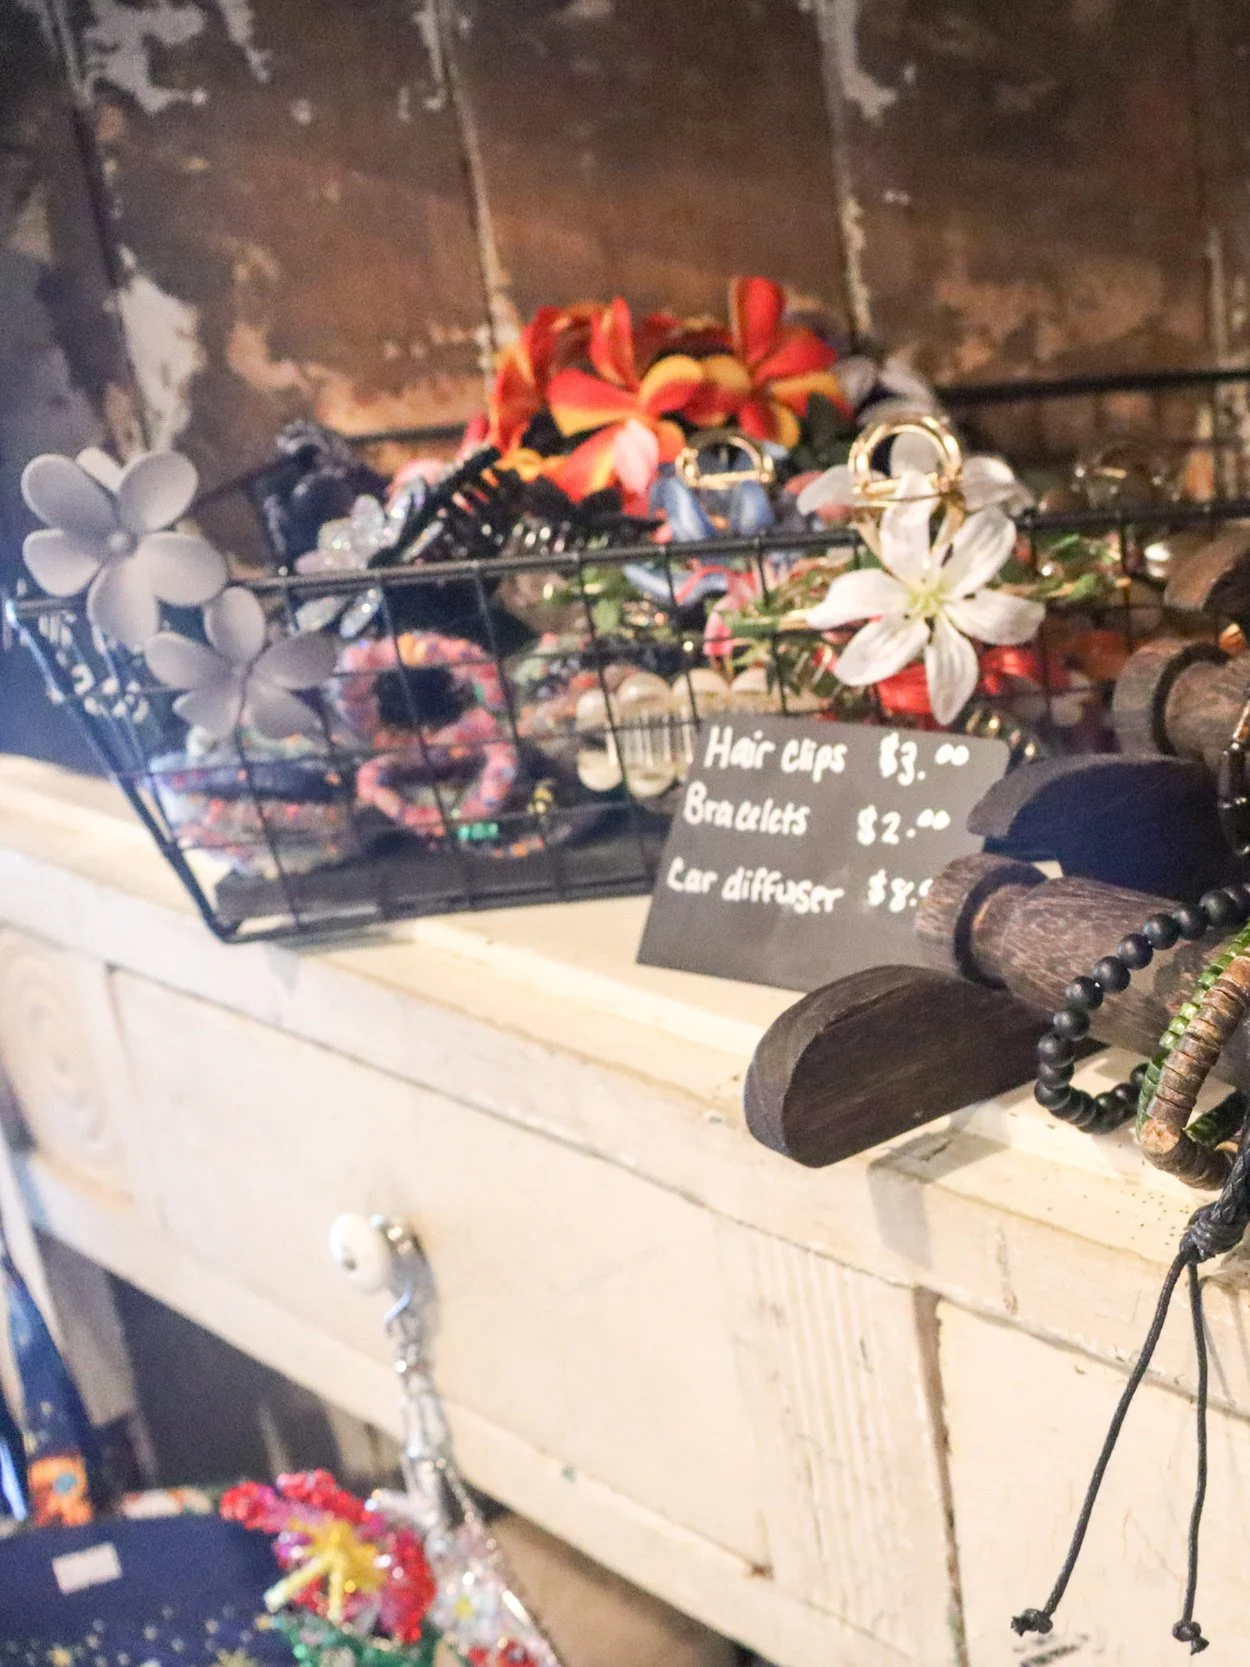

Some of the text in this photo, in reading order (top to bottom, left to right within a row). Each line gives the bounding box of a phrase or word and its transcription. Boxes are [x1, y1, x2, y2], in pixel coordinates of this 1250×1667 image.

[703, 725, 775, 769] Hair
[683, 781, 950, 845] Bracelets $2.00
[667, 856, 718, 893] Car
[721, 865, 845, 914] diffuser
